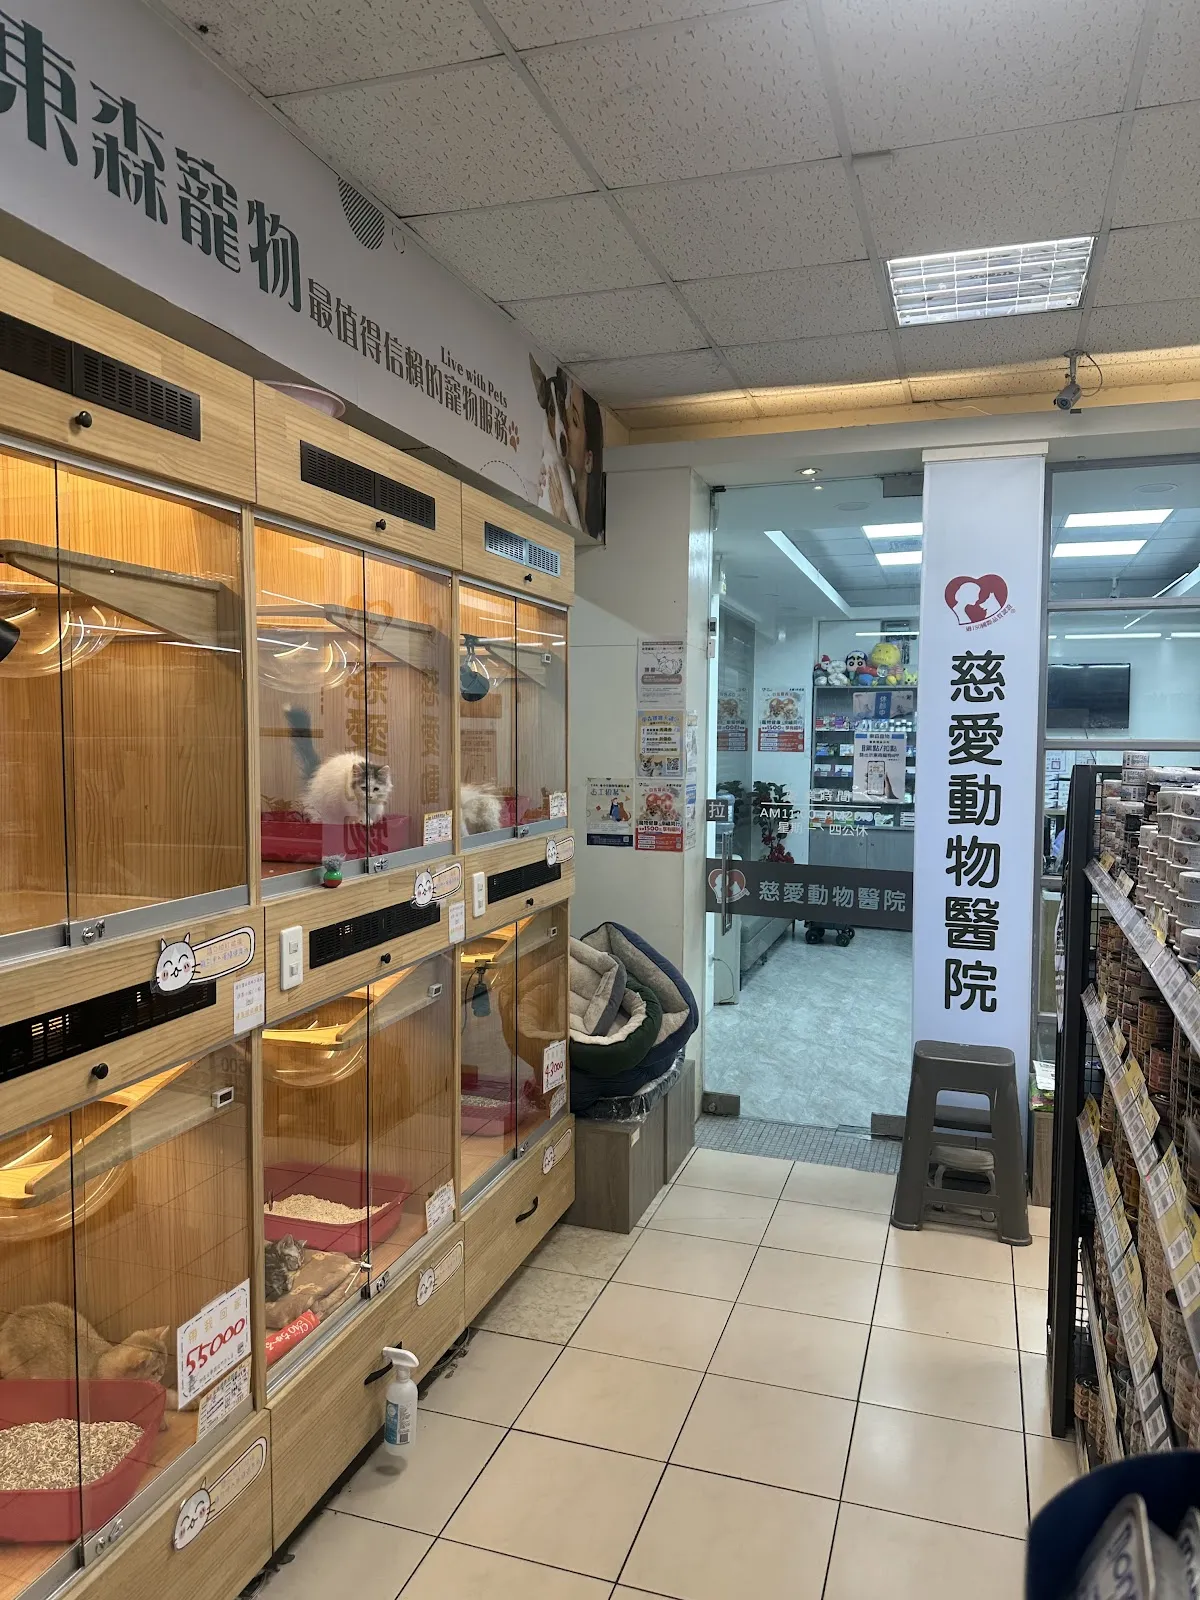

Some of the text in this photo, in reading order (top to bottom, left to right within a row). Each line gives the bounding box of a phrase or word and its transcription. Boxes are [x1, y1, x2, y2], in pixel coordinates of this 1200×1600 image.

[308, 277, 507, 447] 最值得信賴的寵物服務
[441, 346, 508, 408] Live with Pets
[708, 801, 726, 819] 拉
[943, 649, 1006, 1013] 慈愛動物醫院
[758, 880, 907, 913] 慈愛動物醫院
[186, 1317, 246, 1376] 55000
